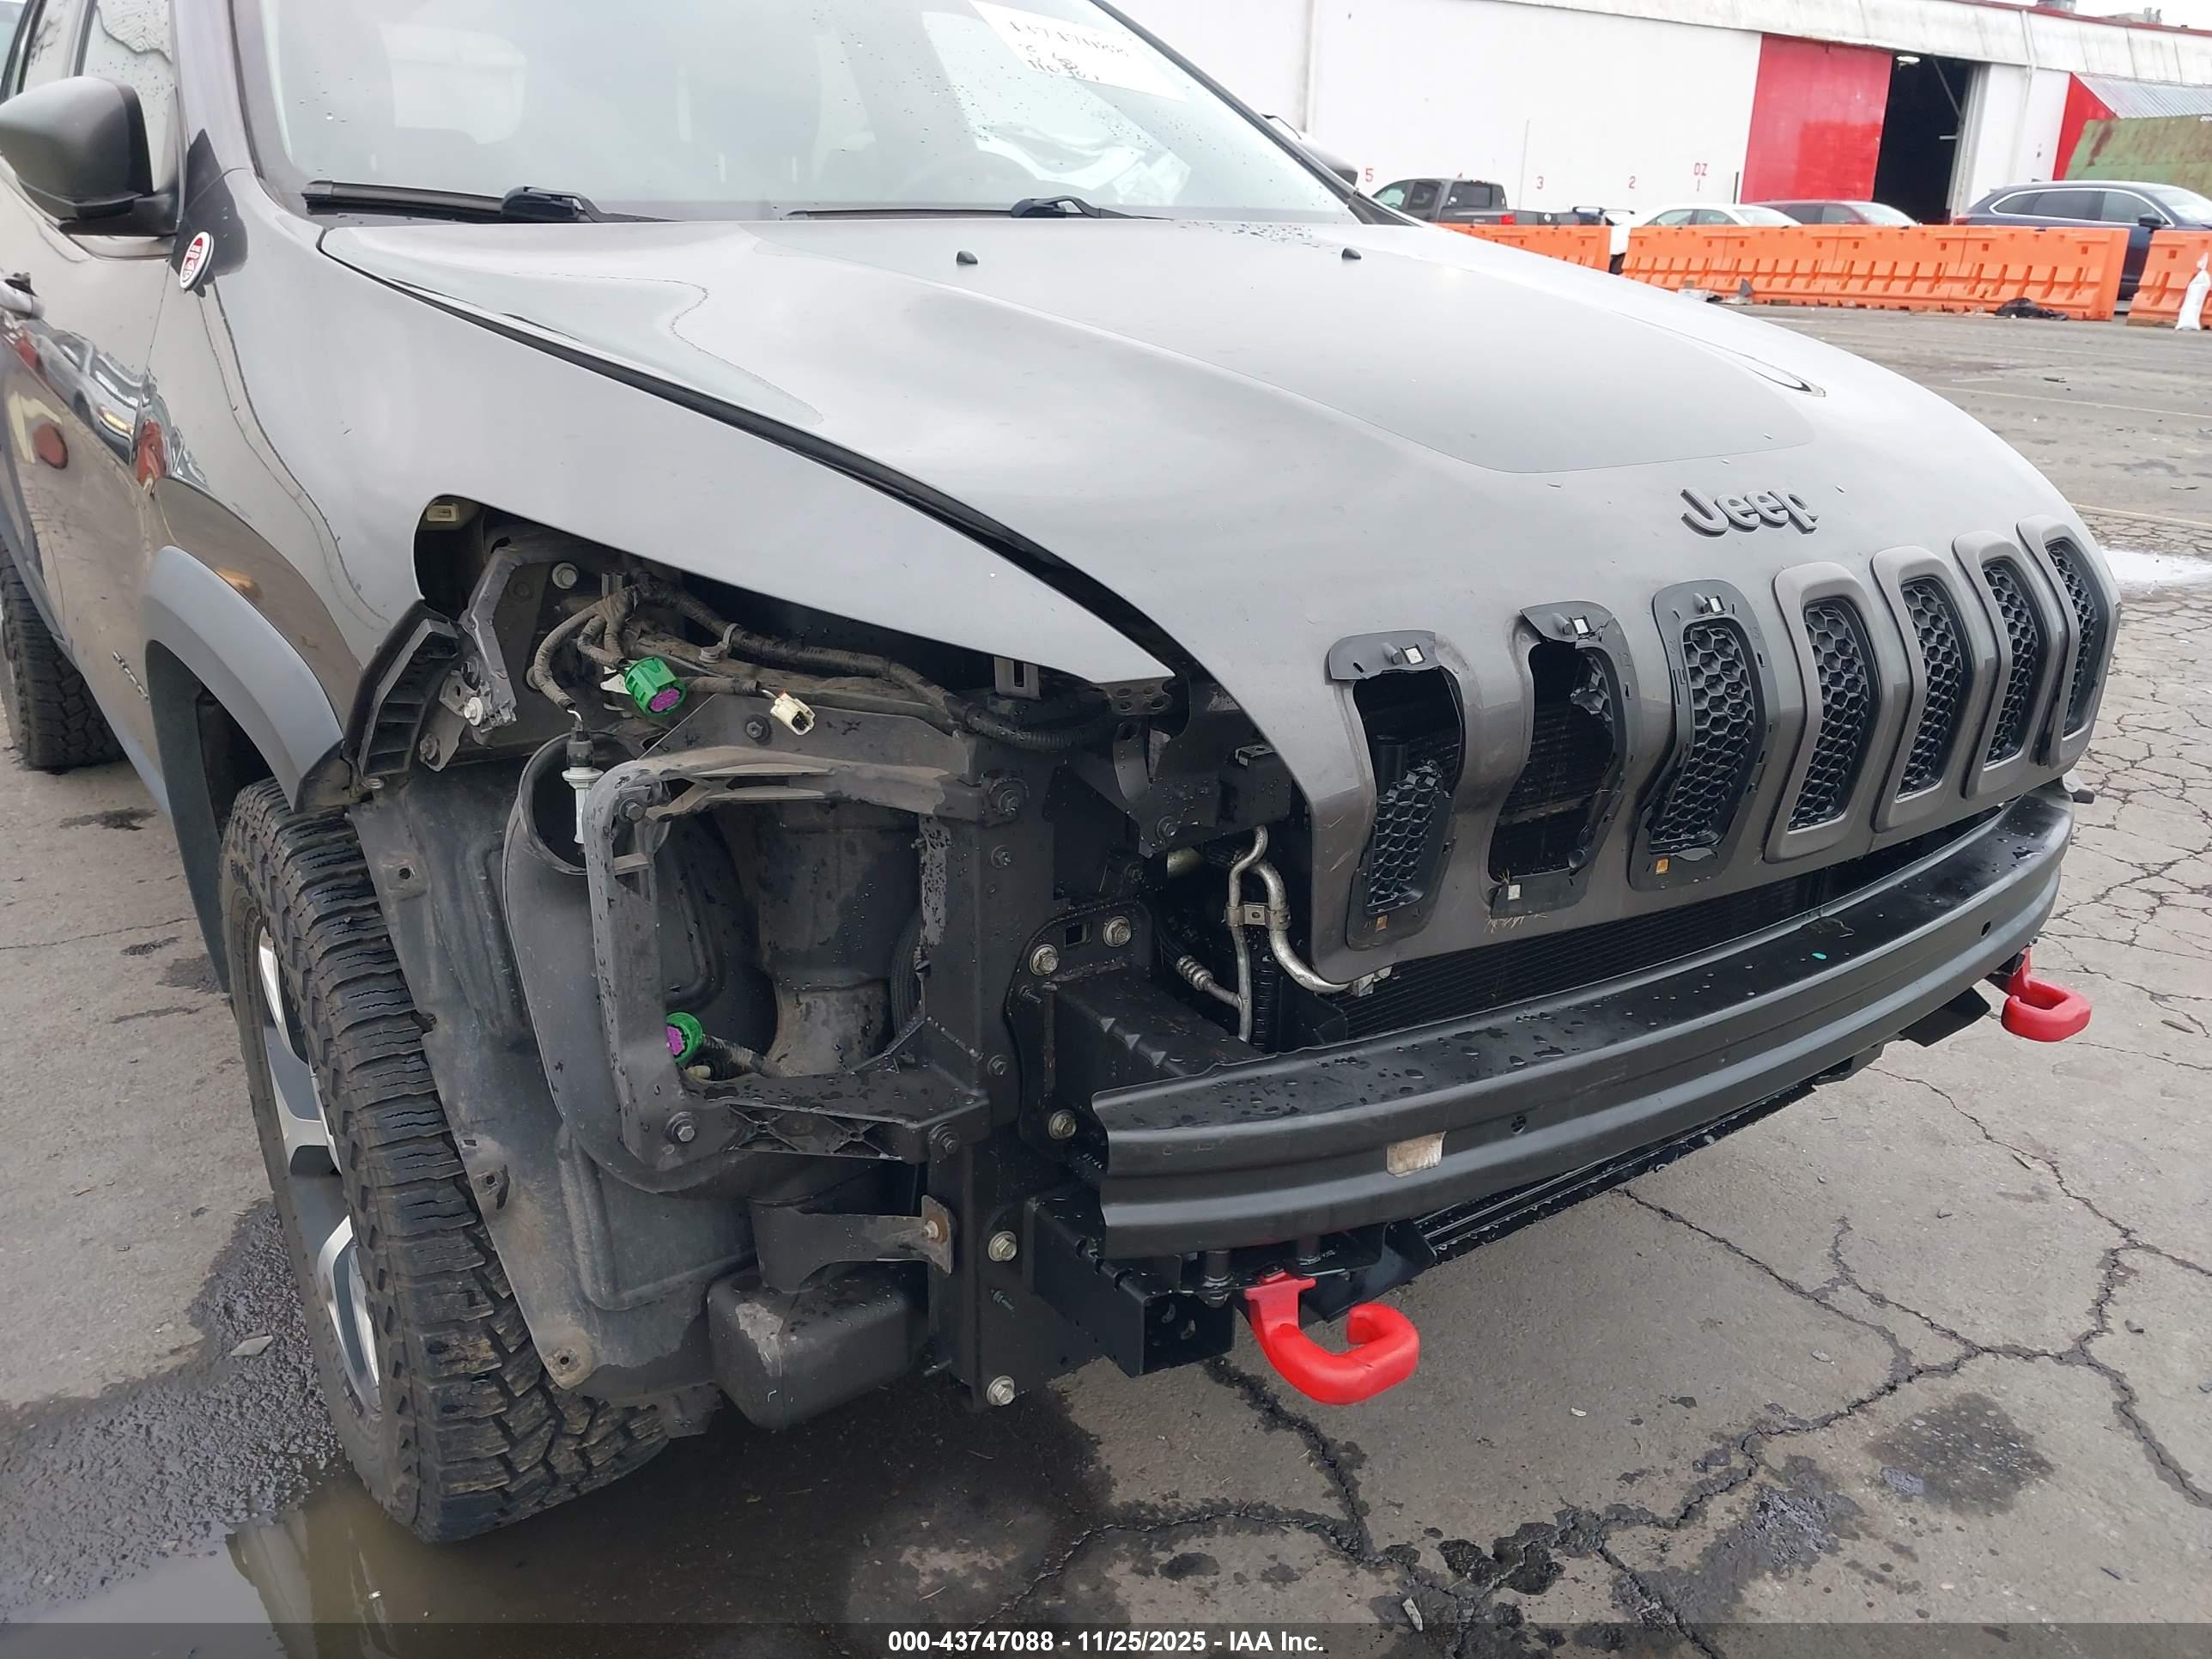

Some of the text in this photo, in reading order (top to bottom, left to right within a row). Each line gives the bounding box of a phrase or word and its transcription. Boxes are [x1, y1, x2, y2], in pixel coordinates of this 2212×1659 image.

[1365, 167, 1374, 182] 5
[1536, 176, 1545, 190] 3
[1628, 175, 1638, 190] 2
[1680, 488, 1819, 538] Jeep
